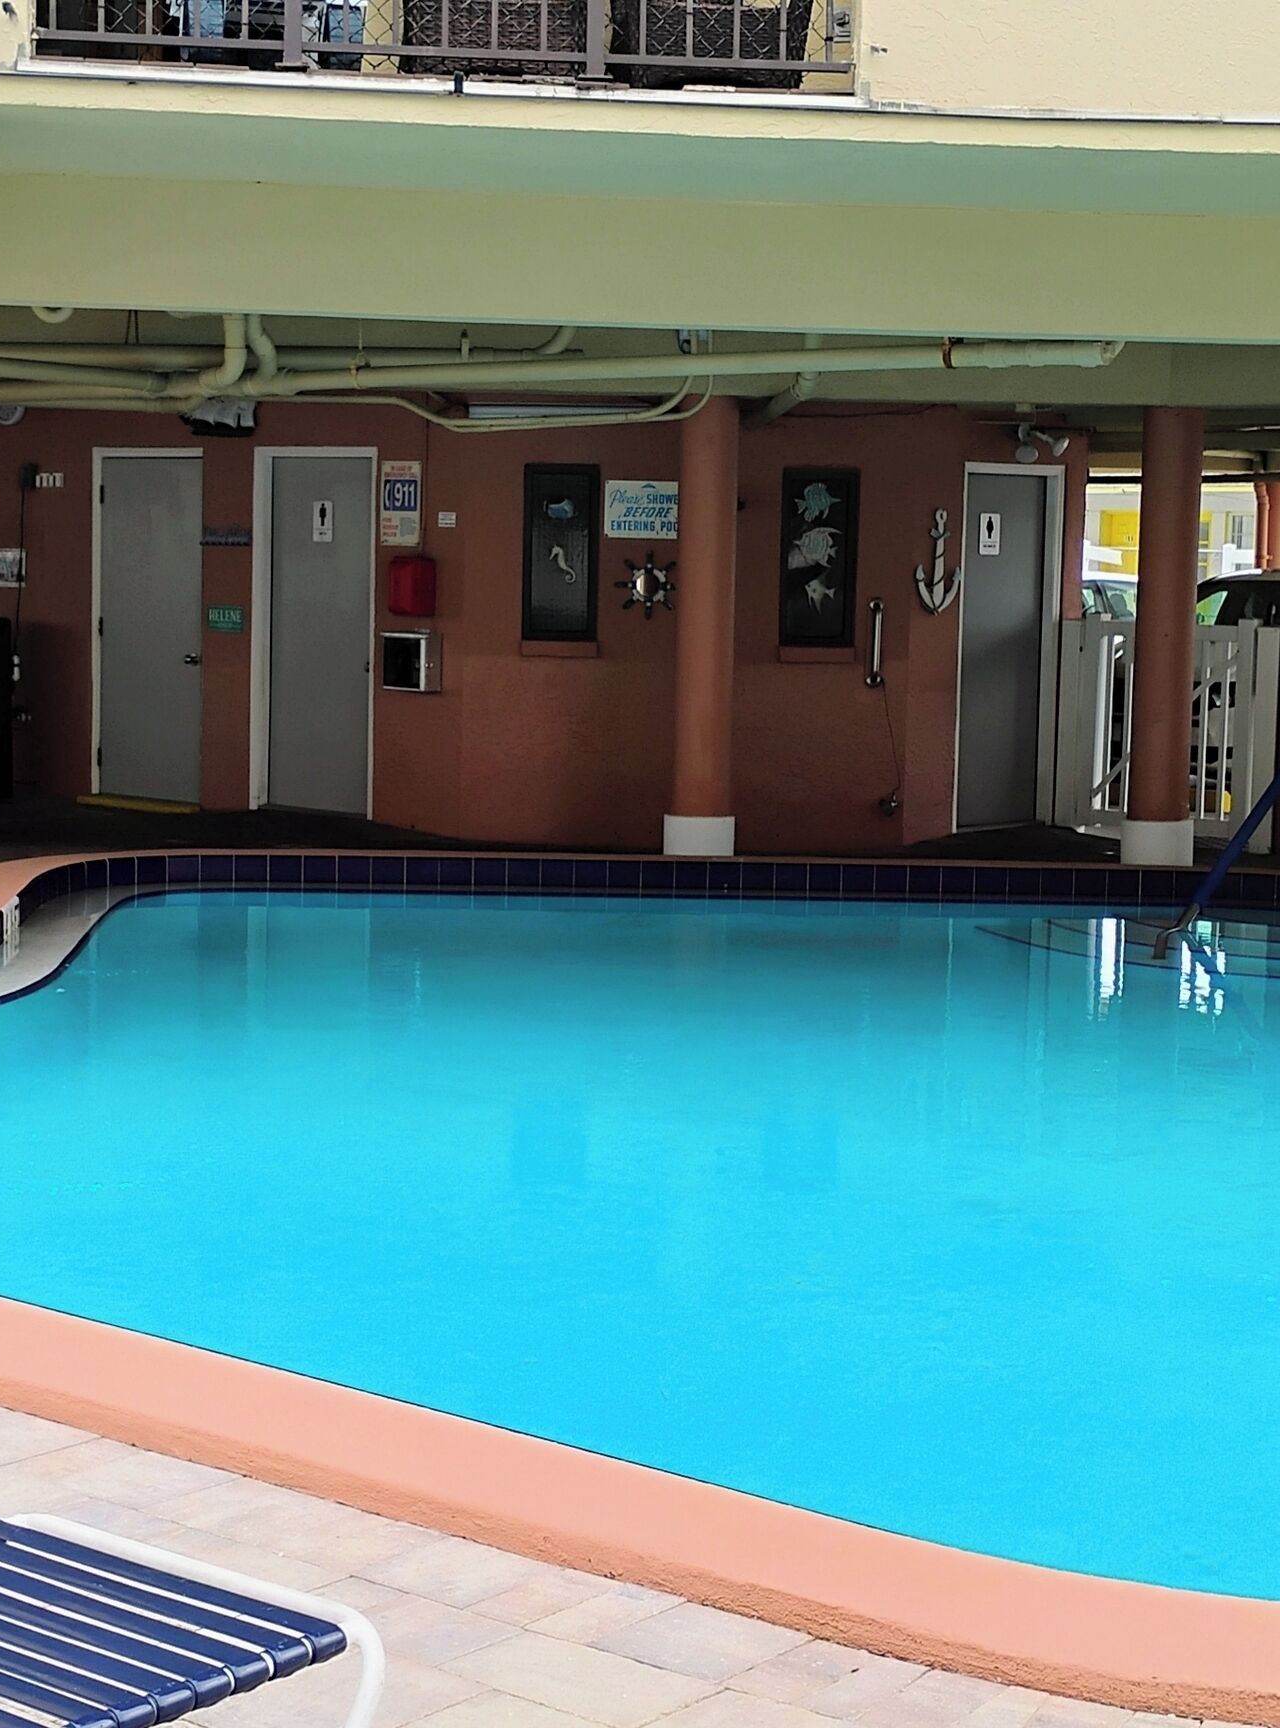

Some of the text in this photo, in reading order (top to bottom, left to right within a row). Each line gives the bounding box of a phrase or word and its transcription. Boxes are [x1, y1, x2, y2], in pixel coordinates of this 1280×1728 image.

[394, 482, 415, 507] 911
[610, 488, 644, 508] Please
[624, 507, 673, 518] BEFORE
[611, 520, 655, 532] ENTERING
[209, 608, 242, 623] HELENE
